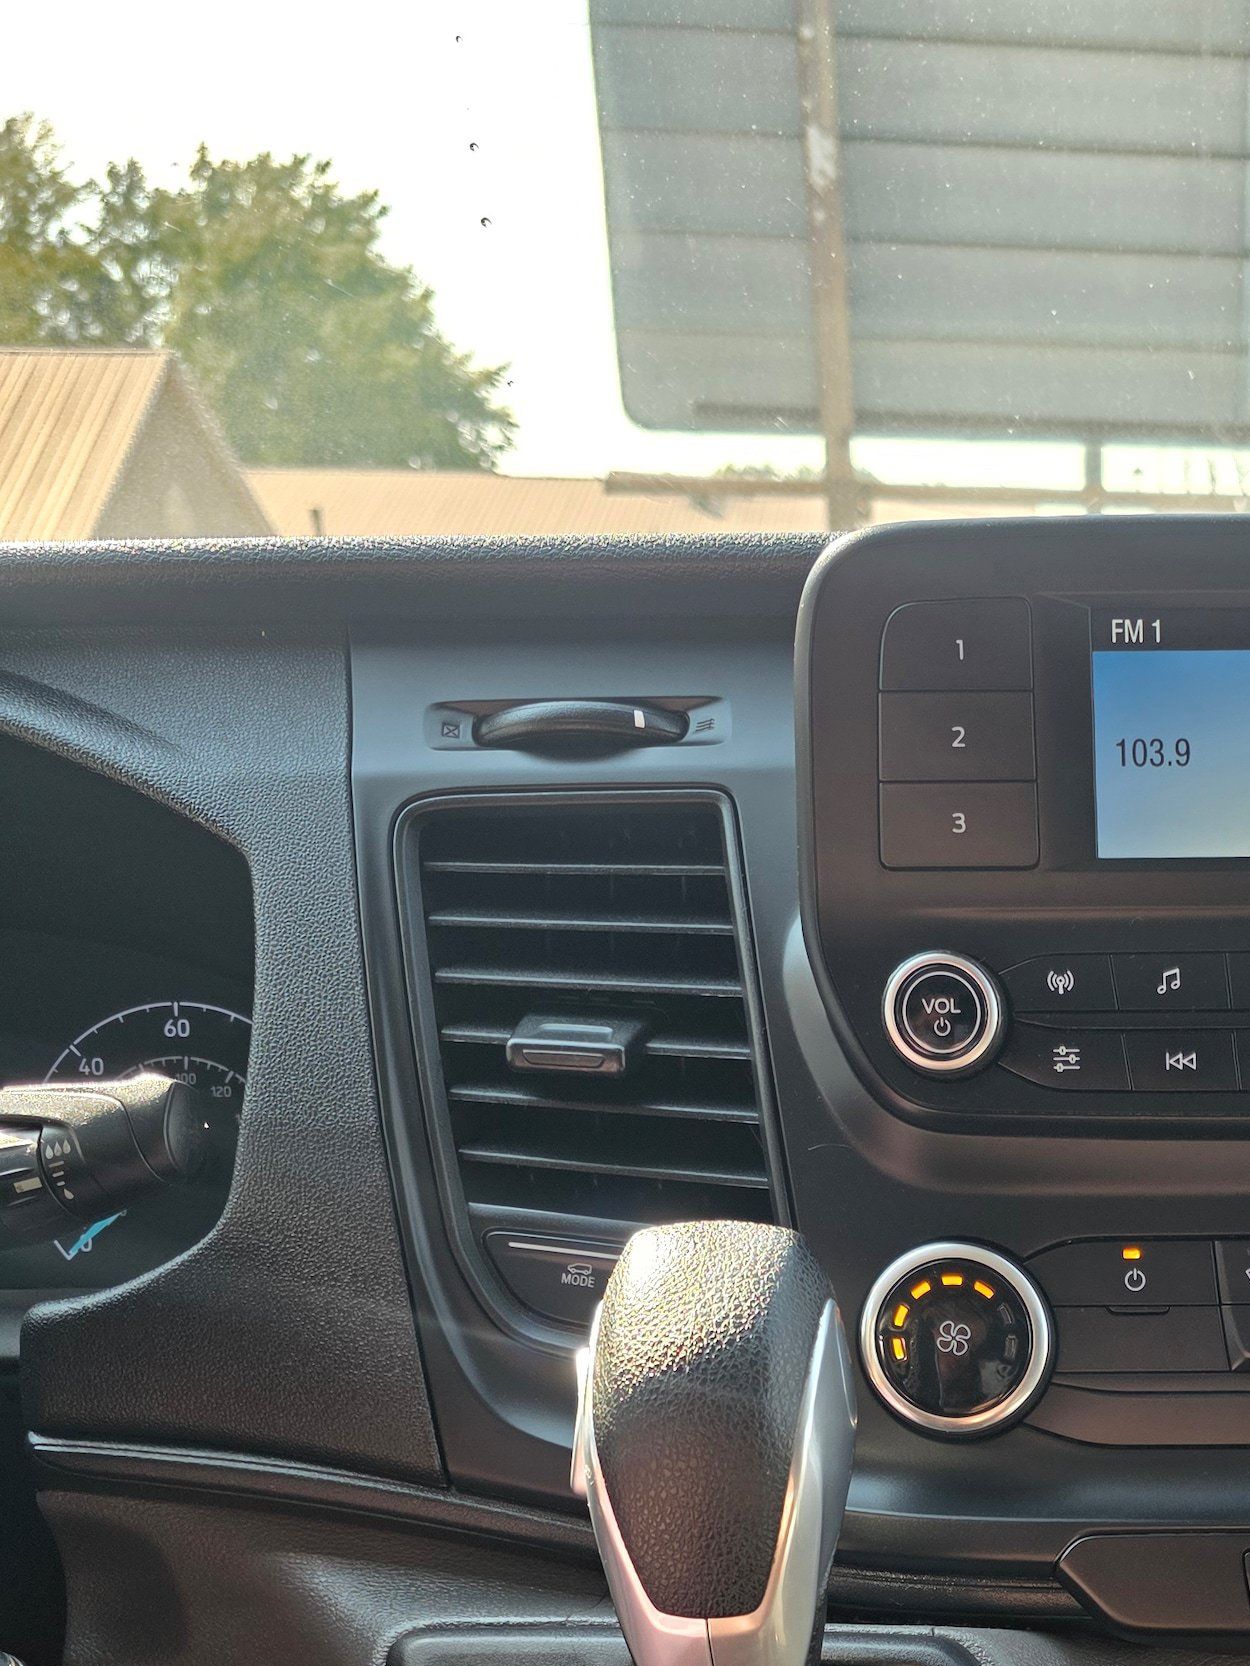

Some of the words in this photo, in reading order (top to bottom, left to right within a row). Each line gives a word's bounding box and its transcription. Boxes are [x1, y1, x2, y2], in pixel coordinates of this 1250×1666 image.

[1111, 618, 1145, 644] FM
[1151, 619, 1162, 644] 1
[954, 639, 965, 662] 1
[951, 726, 967, 749] 2
[1115, 738, 1192, 768] 103.9
[952, 812, 968, 834] 3
[921, 997, 962, 1015] VOL
[163, 1018, 191, 1038] 60
[78, 1057, 105, 1076] 40
[210, 1085, 232, 1098] 120
[561, 1272, 596, 1288] MODE
